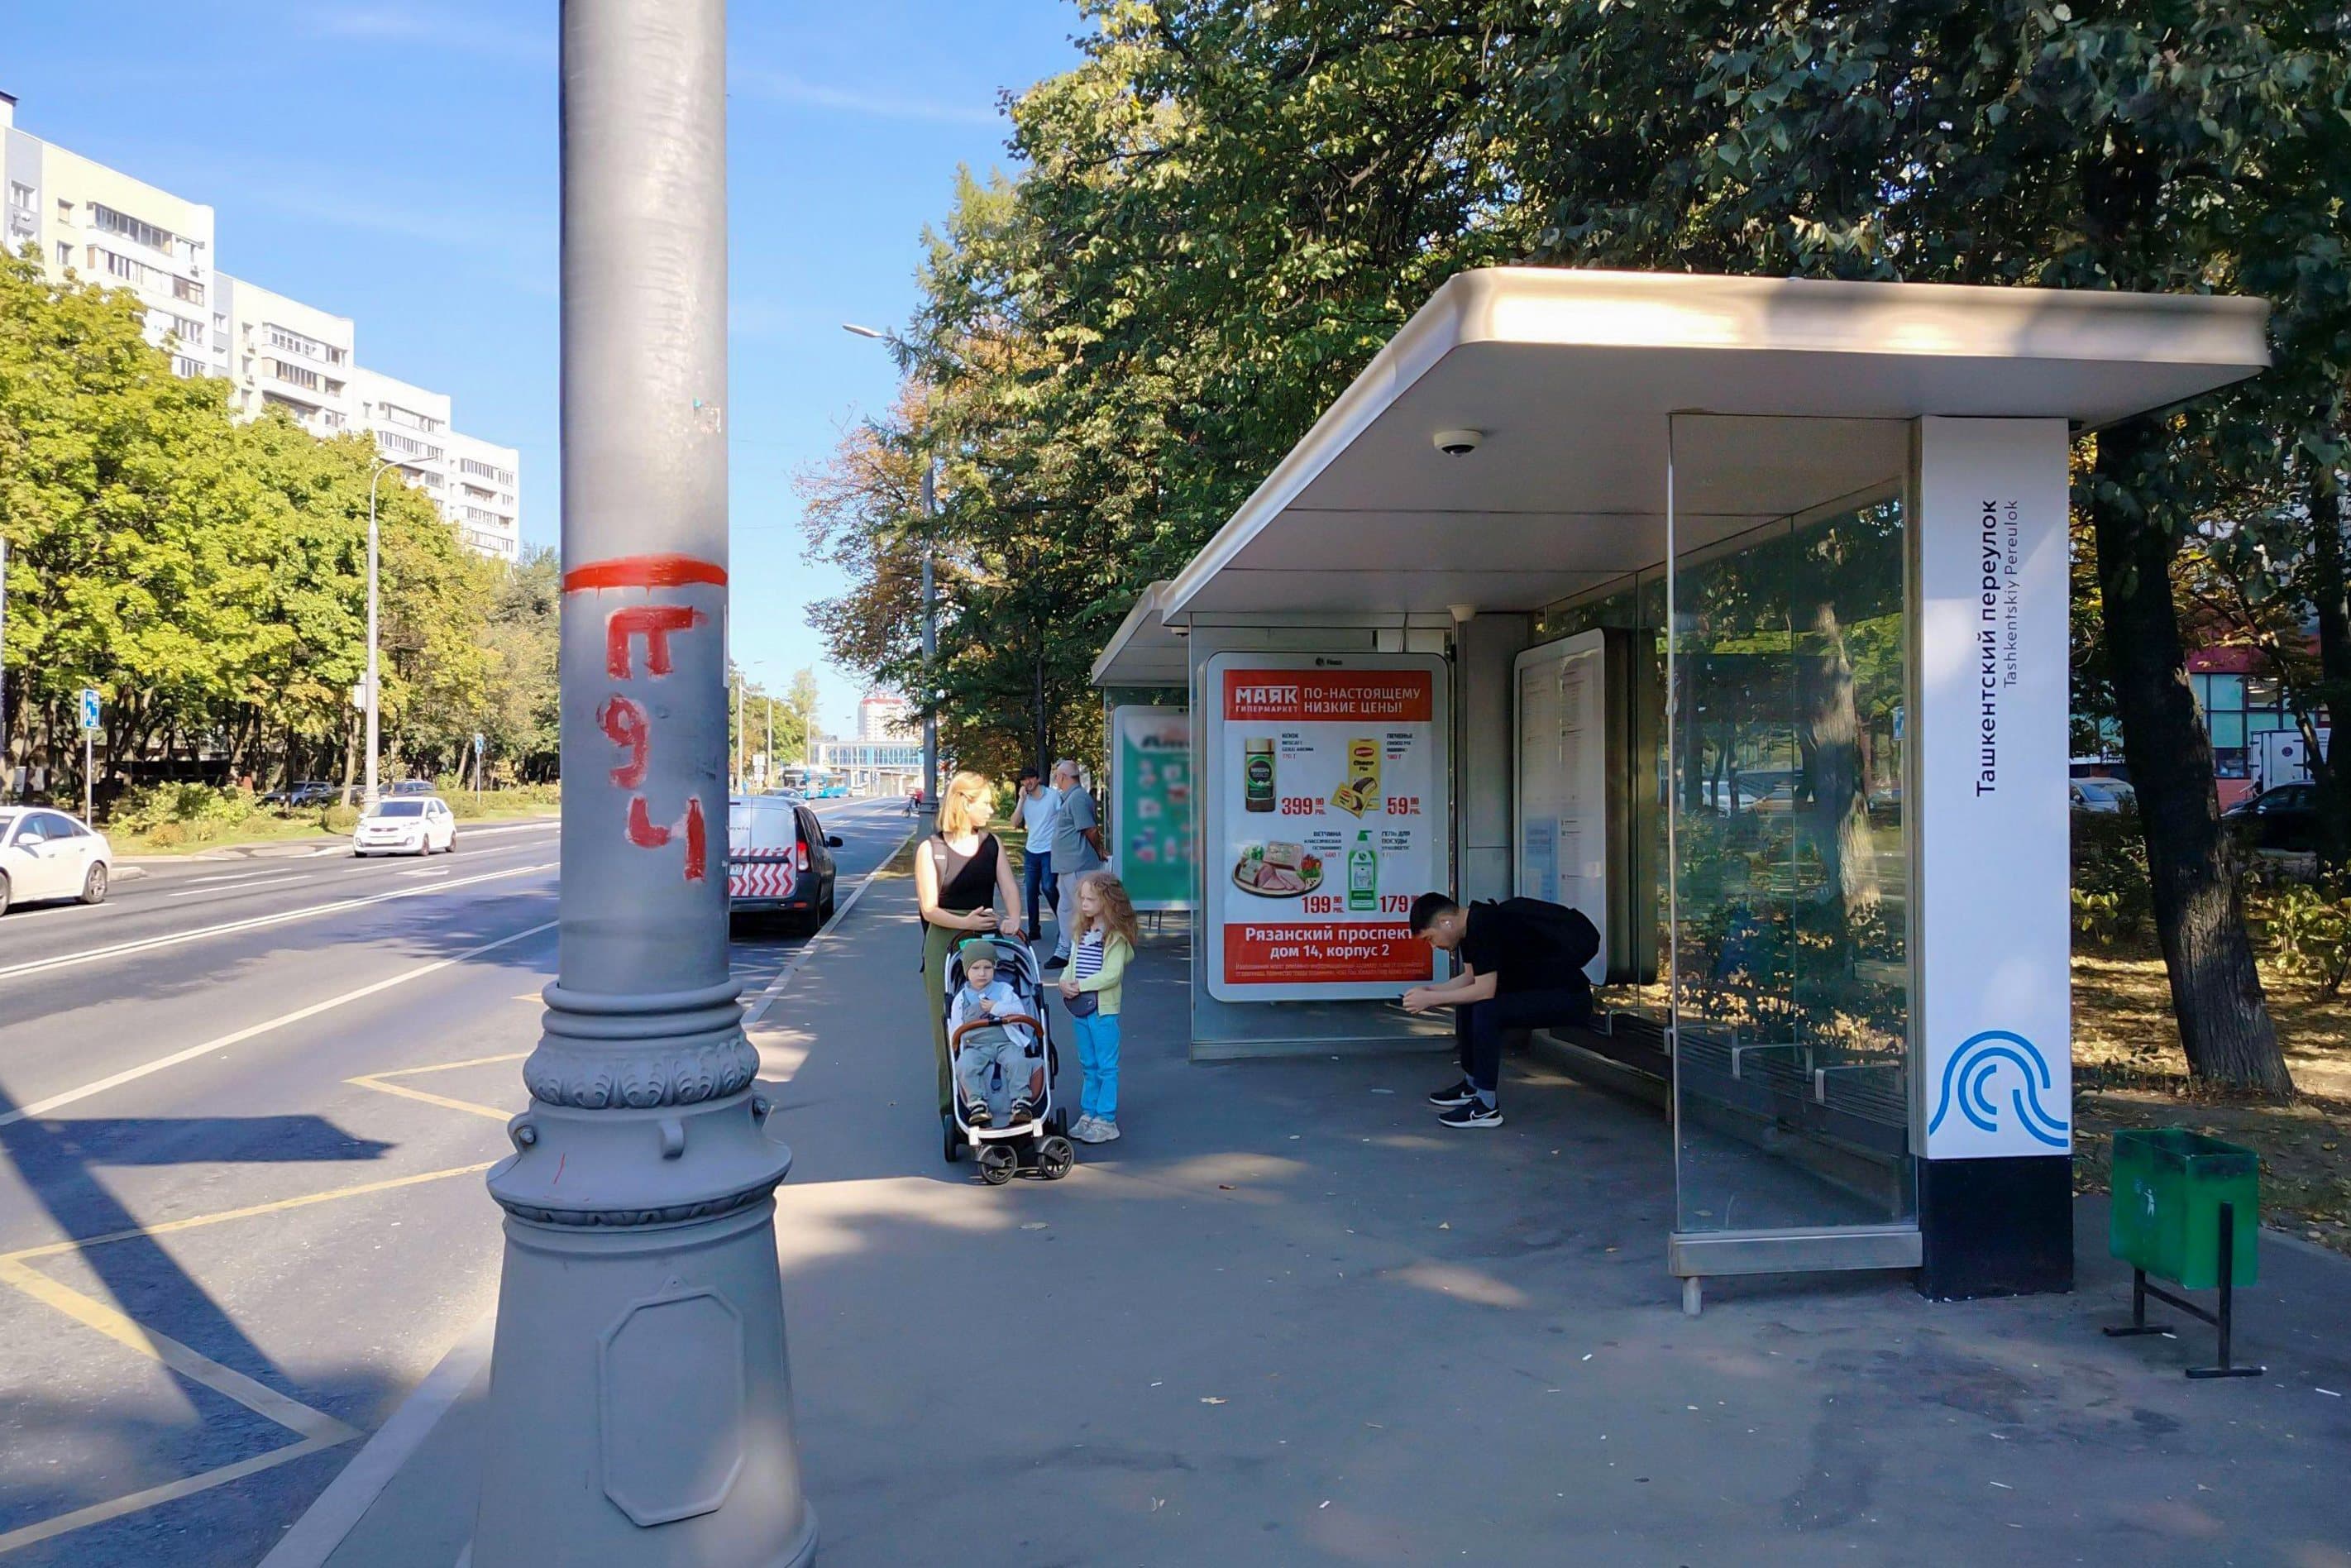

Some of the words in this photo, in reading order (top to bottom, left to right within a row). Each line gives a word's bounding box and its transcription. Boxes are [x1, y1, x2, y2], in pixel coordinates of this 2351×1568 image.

[2005, 500, 2018, 575] Pereulok
[1981, 500, 2001, 621] переулок
[2003, 581, 2020, 689] Tashkentskiy
[1235, 686, 1297, 704] МАЯК
[1304, 687, 1421, 700] ПО-НАСТОЯЩЕМУ
[1235, 705, 1298, 714] ГИПЕРМАРКЕТ
[1304, 702, 1355, 713] НИЗКИЕ
[1361, 701, 1402, 714] ЦЕНЫ!
[1976, 633, 1997, 796] Ташкентский
[1282, 797, 1312, 815] 399
[1388, 796, 1407, 815] 59
[1302, 896, 1331, 914] 199
[1380, 896, 1408, 913] 179
[1245, 926, 1333, 941] Рязанский
[1270, 946, 1299, 959] дом
[1304, 945, 1322, 959] 14,
[1326, 946, 1379, 959] корпус
[1382, 944, 1390, 956] 2
